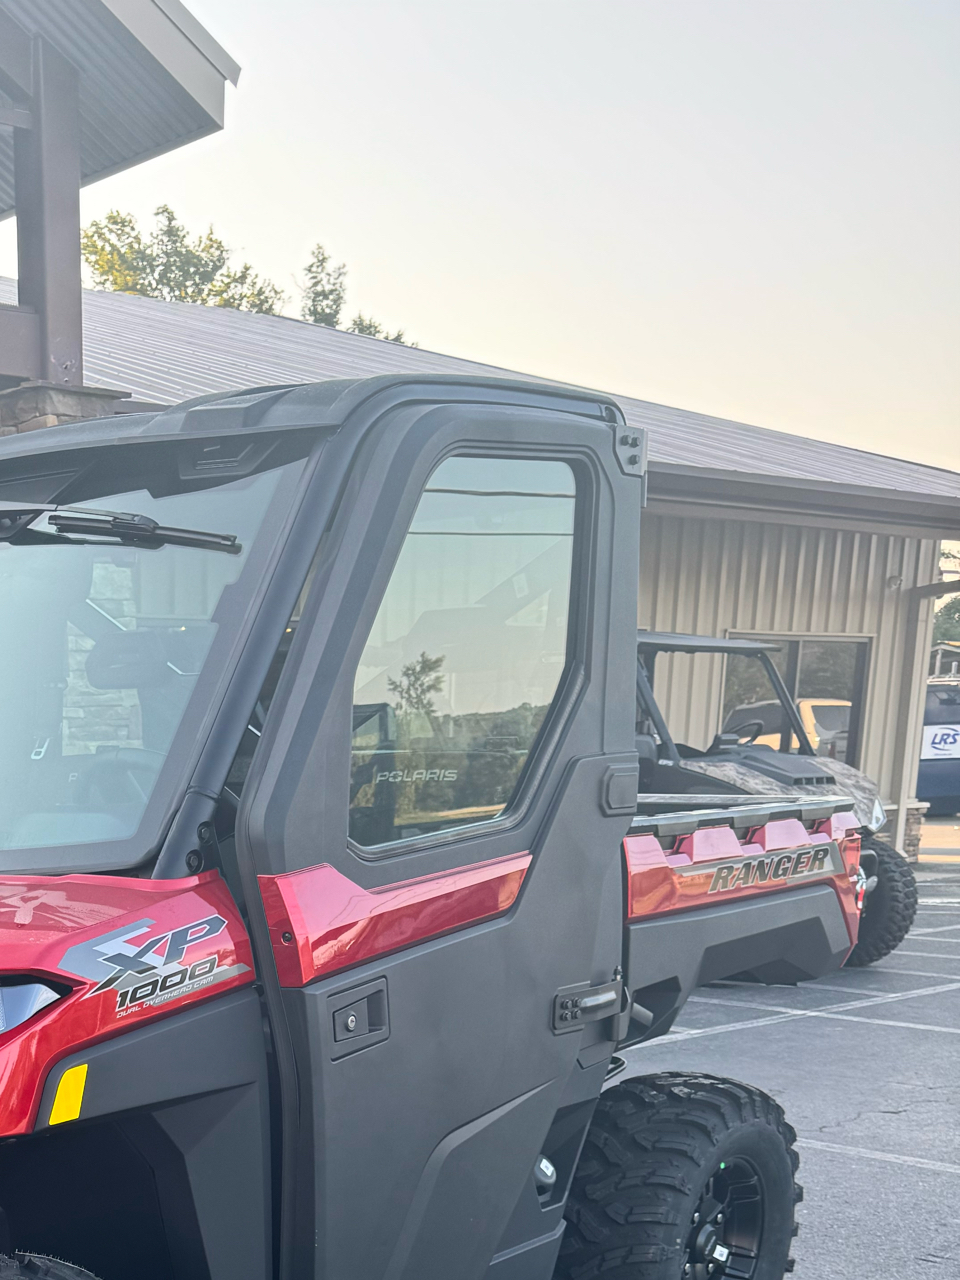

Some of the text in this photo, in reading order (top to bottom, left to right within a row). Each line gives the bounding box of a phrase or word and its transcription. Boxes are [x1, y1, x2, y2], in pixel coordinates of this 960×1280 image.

[930, 733, 960, 745] LRS
[376, 769, 458, 784] POLARIS
[707, 846, 830, 894] RANGER
[80, 914, 228, 1001] XP
[115, 955, 218, 1012] 1000
[116, 976, 214, 1018] DUAL OVERHEAD CAM
